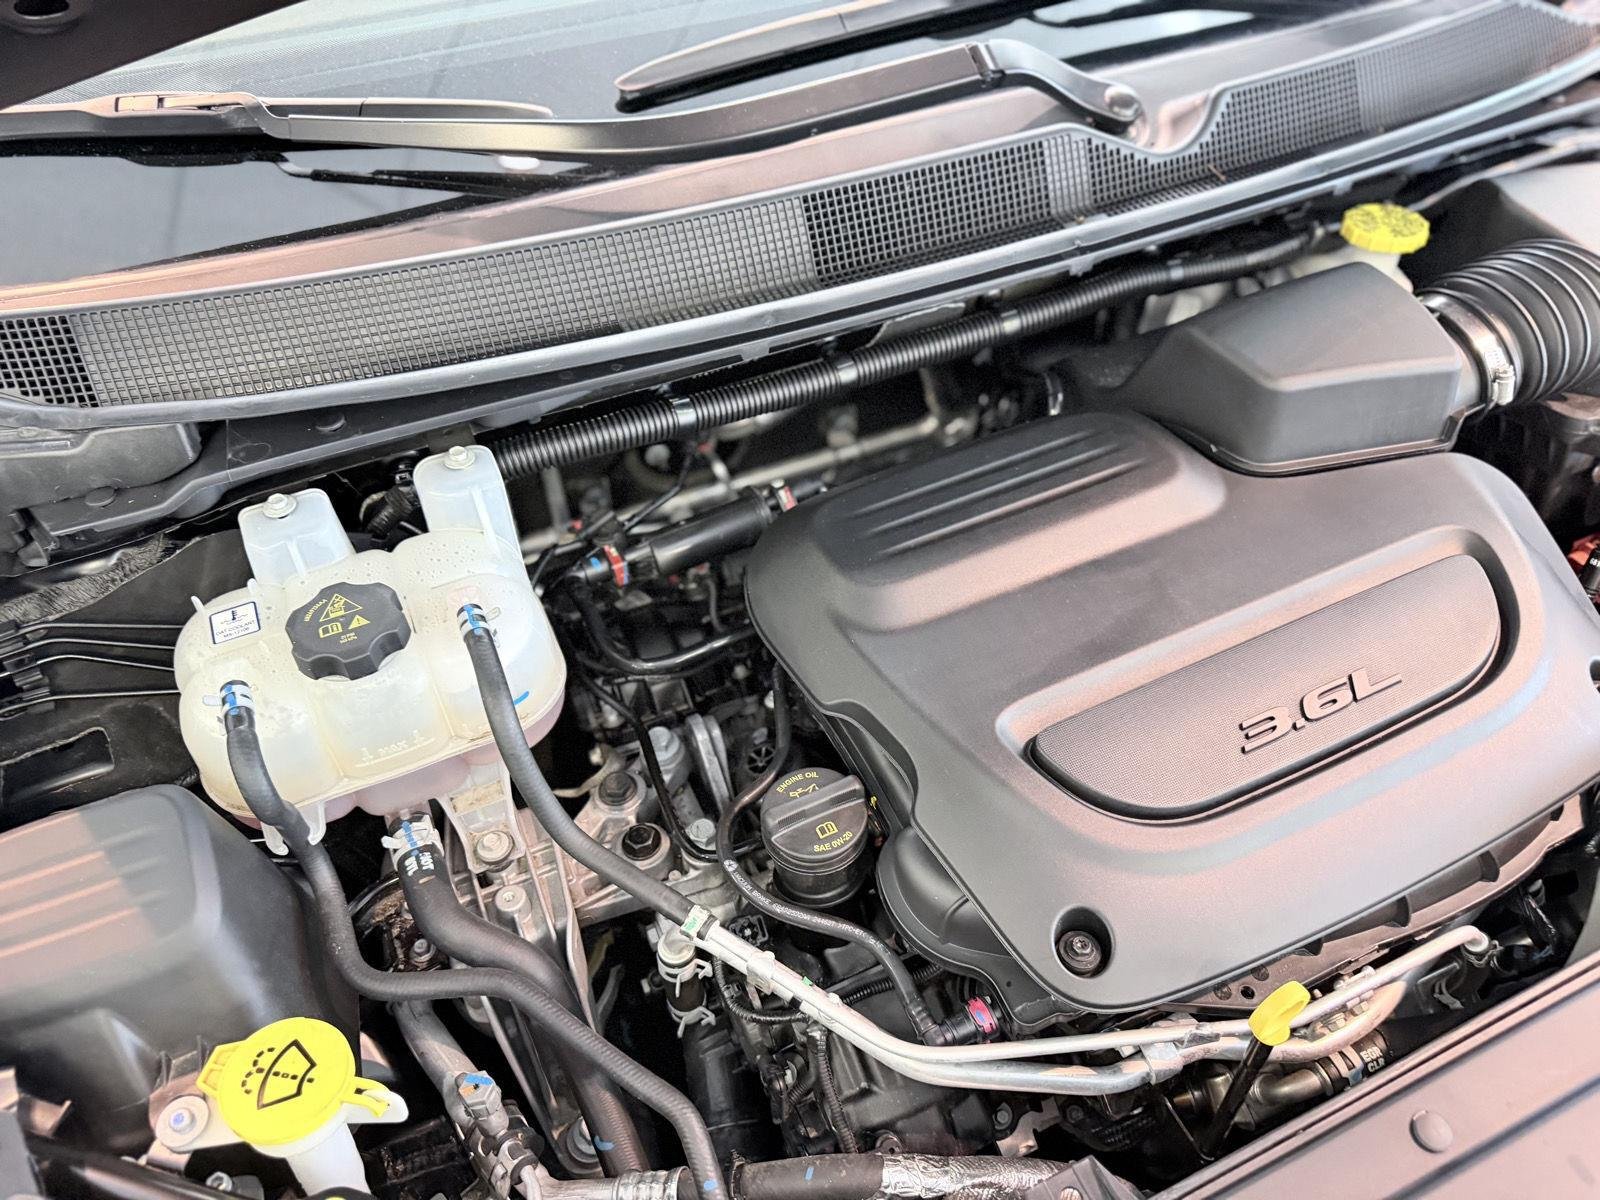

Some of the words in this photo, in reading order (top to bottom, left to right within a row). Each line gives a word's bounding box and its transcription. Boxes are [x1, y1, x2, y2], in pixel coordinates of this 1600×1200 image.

[1238, 667, 1402, 755] 3.6L
[776, 773, 804, 793] ENGINE
[805, 771, 819, 779] OIL
[813, 843, 831, 852] SAE
[832, 831, 853, 848] 0W-20
[1359, 1046, 1383, 1064] EGR
[1367, 1057, 1386, 1074] CLR
